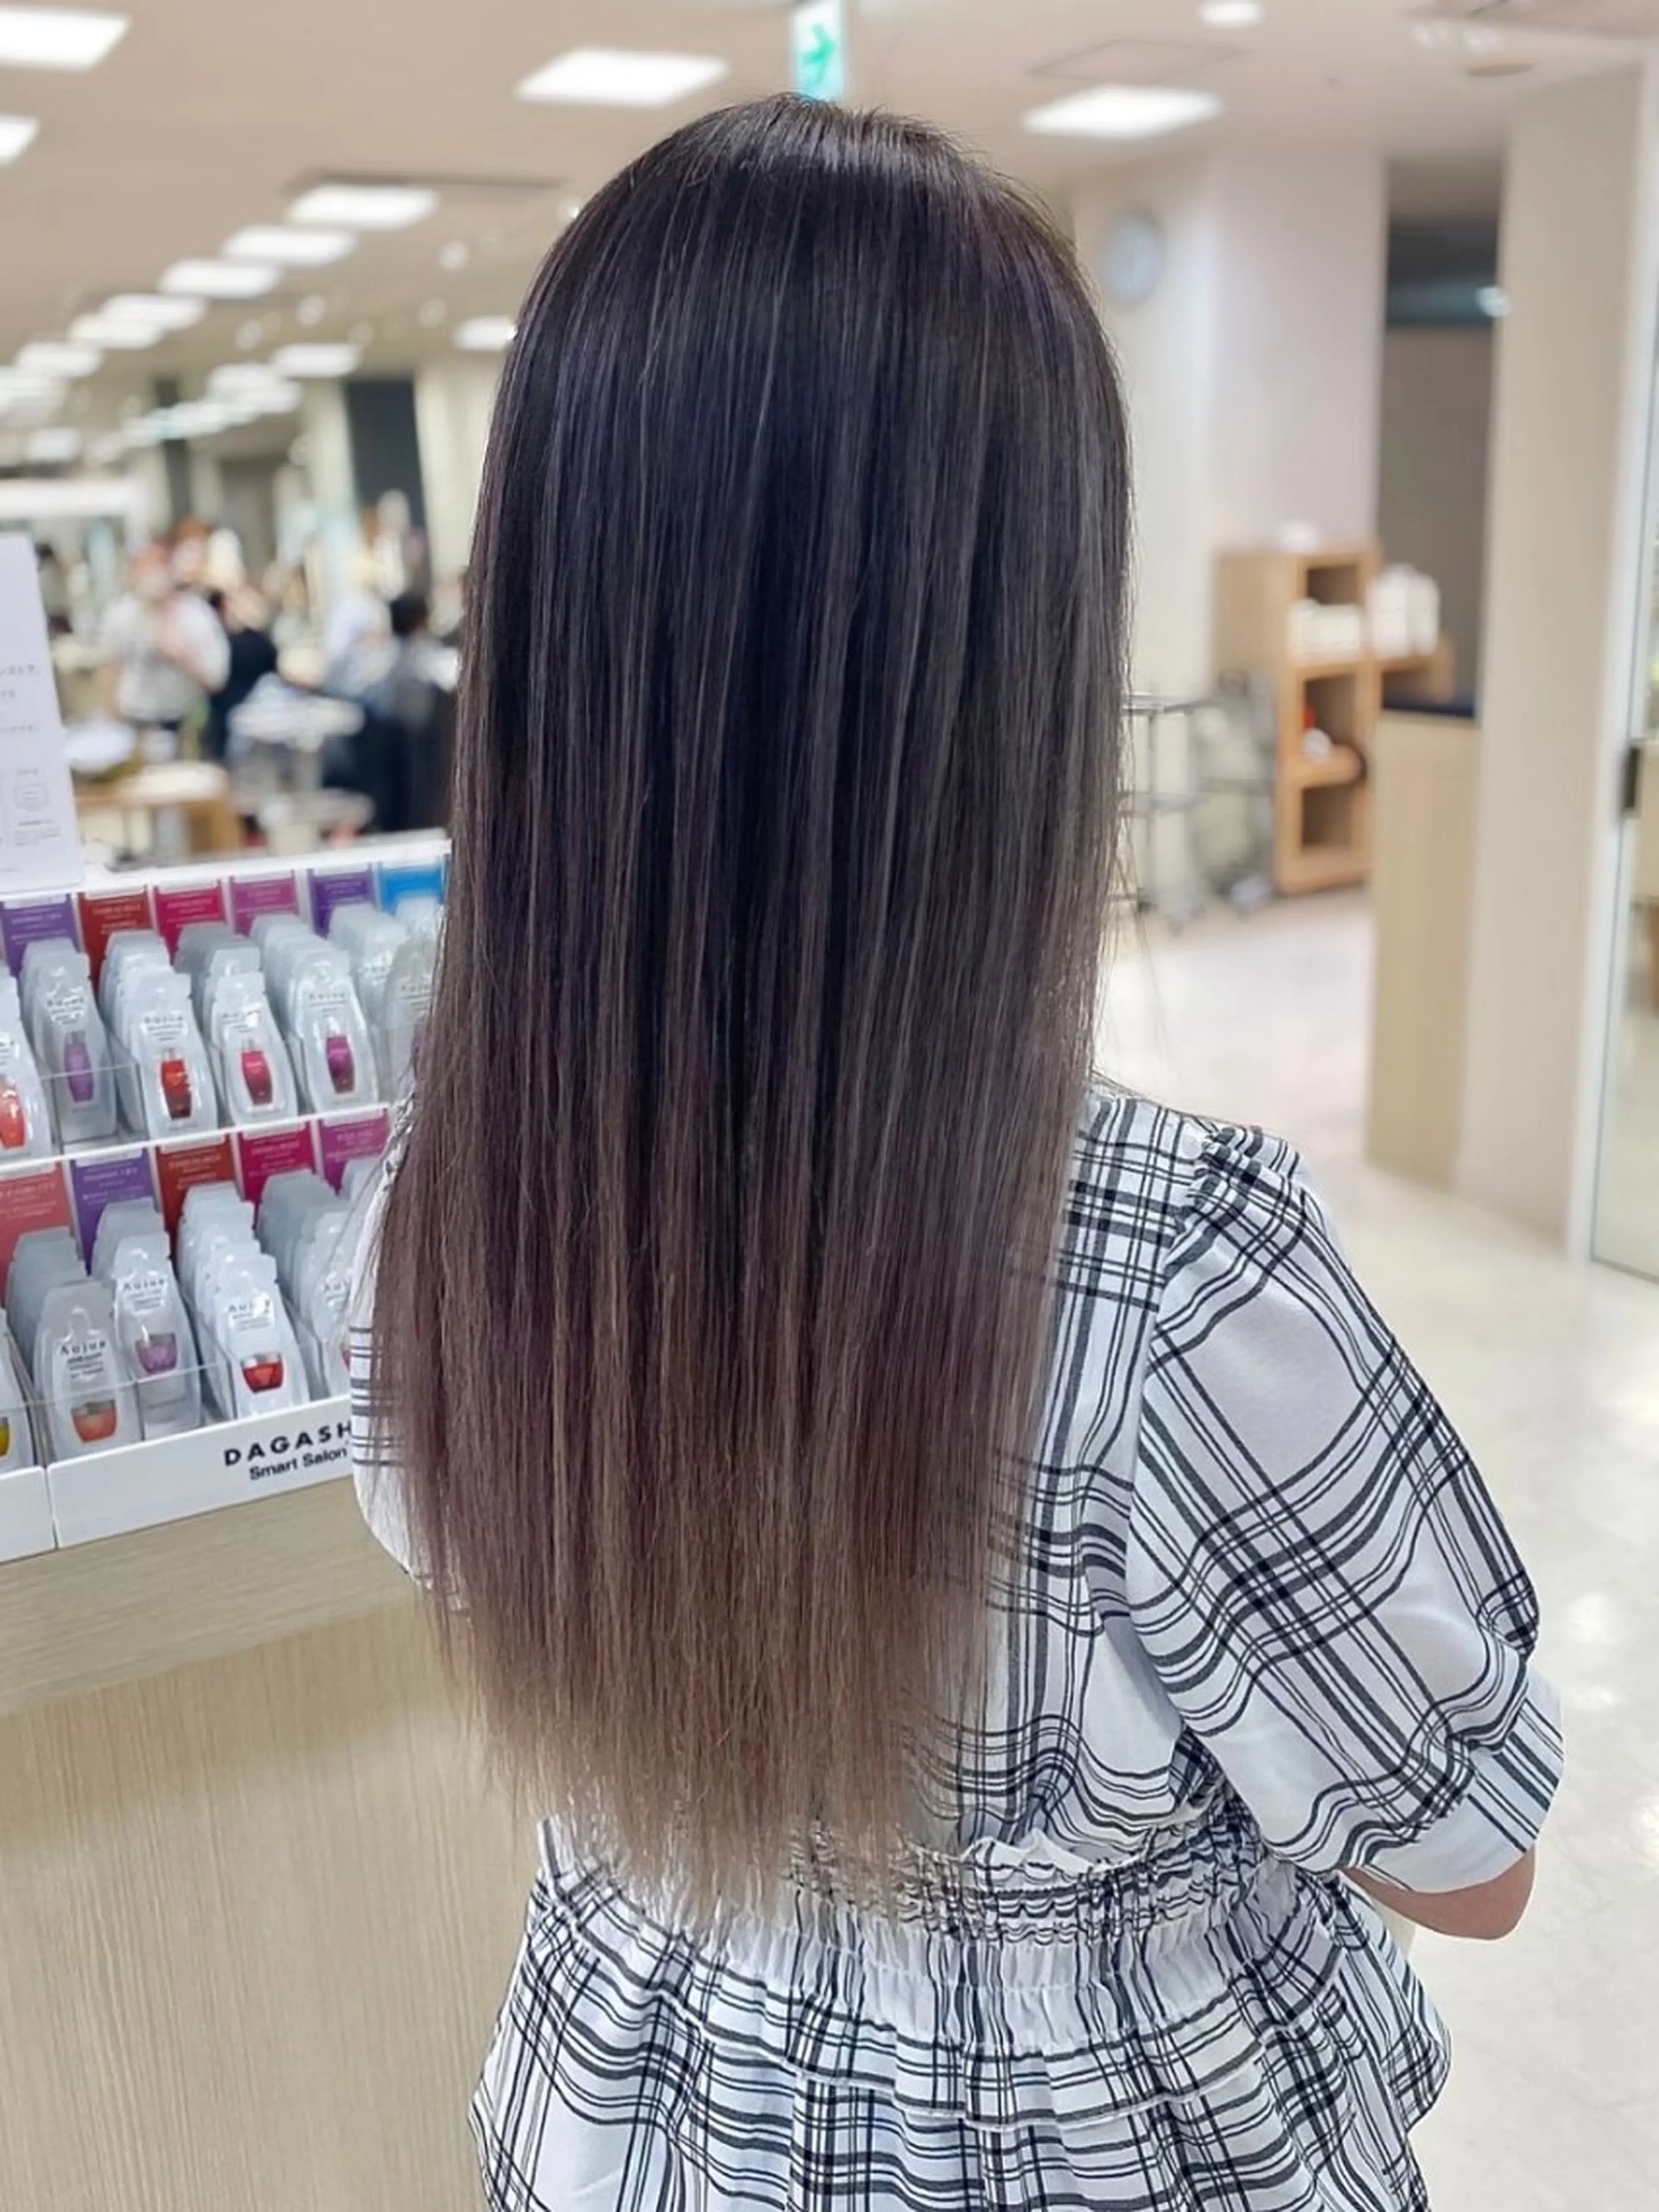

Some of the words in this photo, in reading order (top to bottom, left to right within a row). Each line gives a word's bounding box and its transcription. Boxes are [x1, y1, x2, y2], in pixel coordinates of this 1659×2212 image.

[224, 1420, 351, 1467] DAGASH
[249, 1457, 298, 1481] Smart
[303, 1447, 347, 1468] Salon
